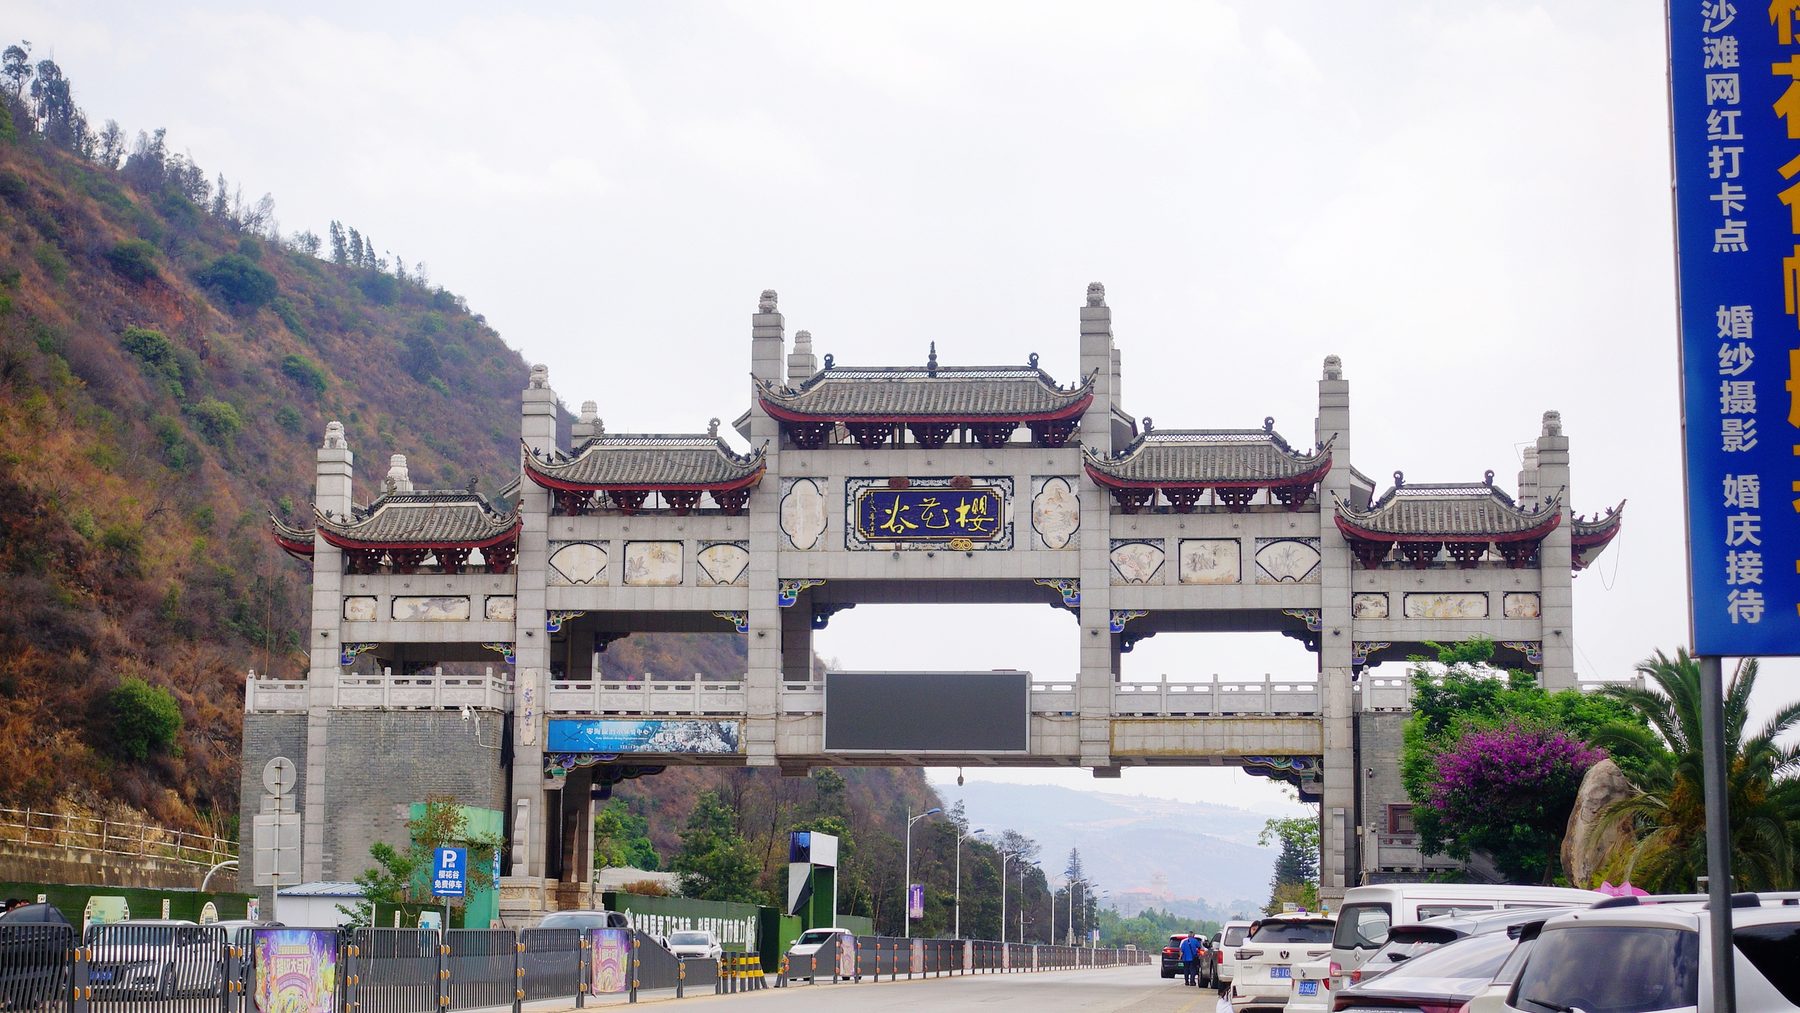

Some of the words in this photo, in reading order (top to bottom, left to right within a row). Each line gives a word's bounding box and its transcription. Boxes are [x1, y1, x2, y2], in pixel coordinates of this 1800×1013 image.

[1700, 0, 1749, 252] 沙滩网红打卡点
[1716, 305, 1758, 452] 婚纱摄影
[1722, 473, 1765, 624] 婚庆接待
[434, 880, 463, 889] 免费停车
[438, 870, 460, 880] 樱花谷
[442, 850, 457, 868] P
